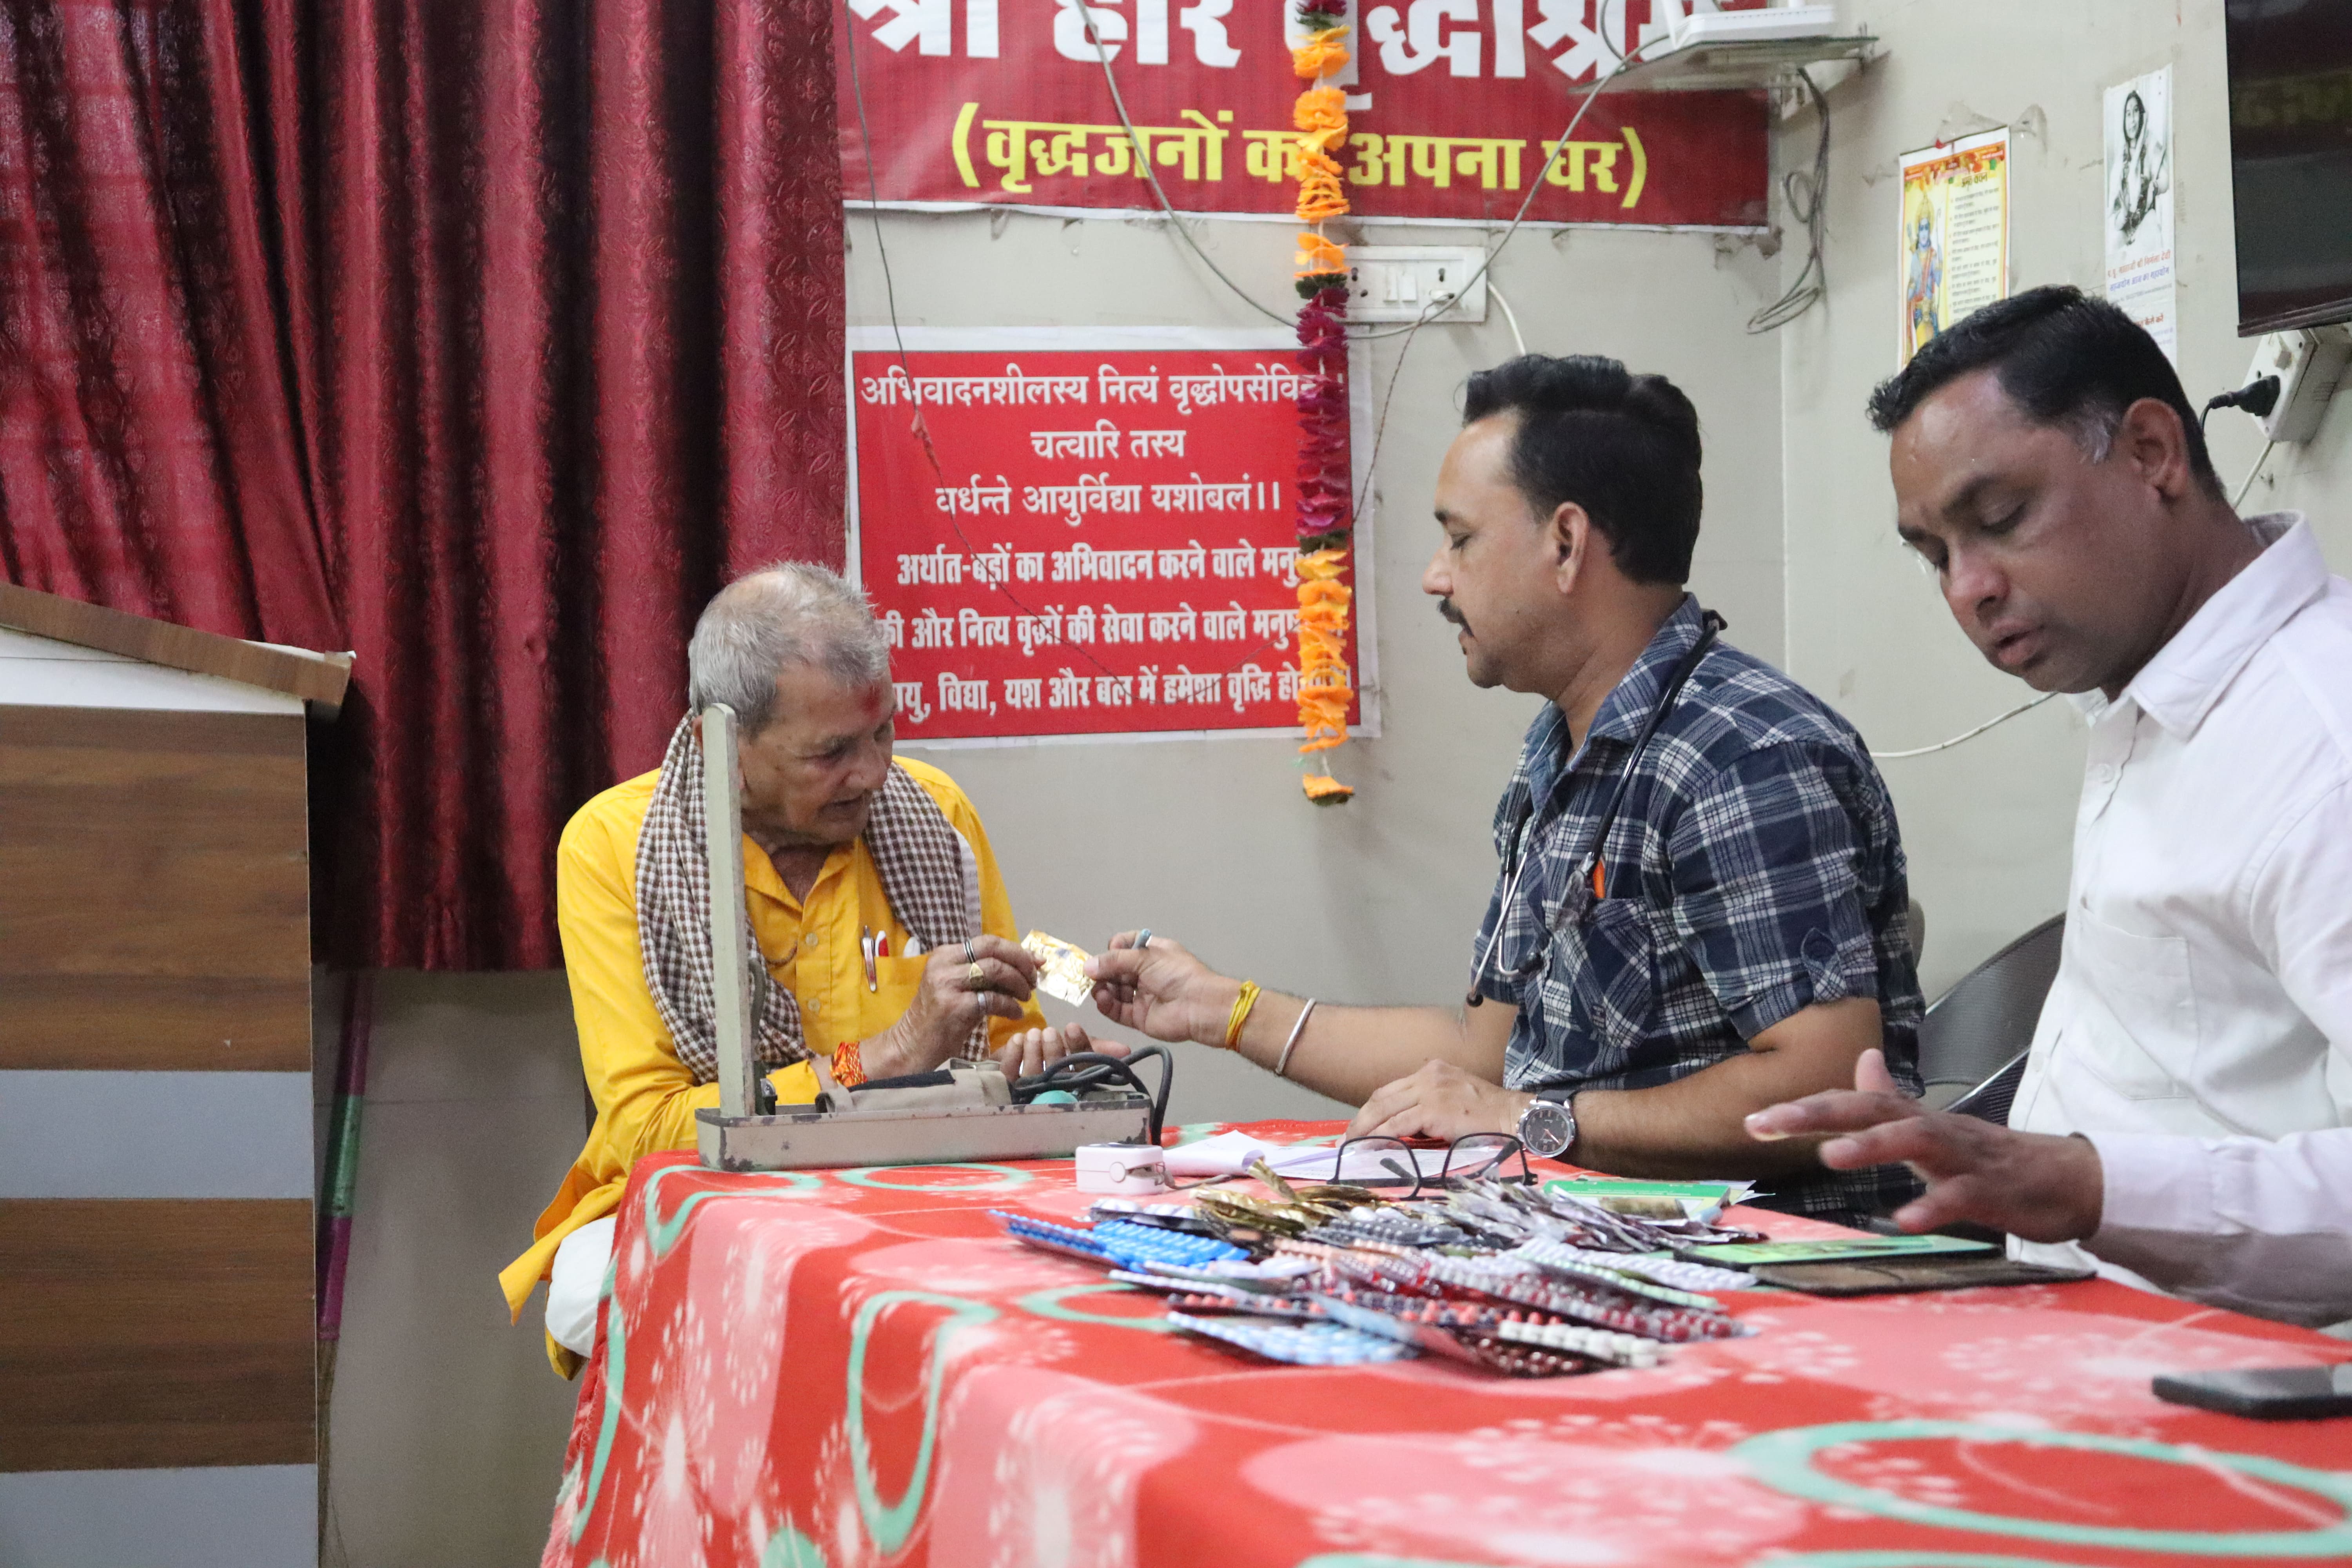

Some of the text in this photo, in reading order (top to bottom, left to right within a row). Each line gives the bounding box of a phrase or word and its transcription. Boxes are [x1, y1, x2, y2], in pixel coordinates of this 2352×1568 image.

[952, 102, 1647, 208] (वृद्धजनों क अपना घर)
[861, 363, 1317, 416] अभिवादनशीलस्य नित्यं वृद्धोपसेवि
[1030, 419, 1187, 459] चत्वारि तस्य
[935, 473, 1012, 515] वर्धन्ते
[1022, 472, 1142, 527] आयुर्विद्या
[1015, 552, 1045, 582] का
[1051, 542, 1155, 583] अभिवादन
[1157, 539, 1206, 579] करने
[1211, 538, 1256, 578] वाले
[911, 607, 954, 648] और
[958, 607, 1011, 647] नित्य
[1016, 604, 1064, 656] वृद्धों
[1066, 605, 1096, 644] की
[1101, 603, 1145, 643] सेवा
[1148, 601, 1197, 642] करने
[1202, 601, 1247, 641] वाले
[893, 681, 931, 724] यु,
[937, 671, 996, 717] विद्या,
[1004, 678, 1042, 709] यश
[1049, 667, 1091, 707] और
[1095, 675, 1134, 706] बल
[1138, 664, 1159, 704] में
[1163, 664, 1222, 704] हमेशा
[1227, 663, 1272, 713] वृद्धि
